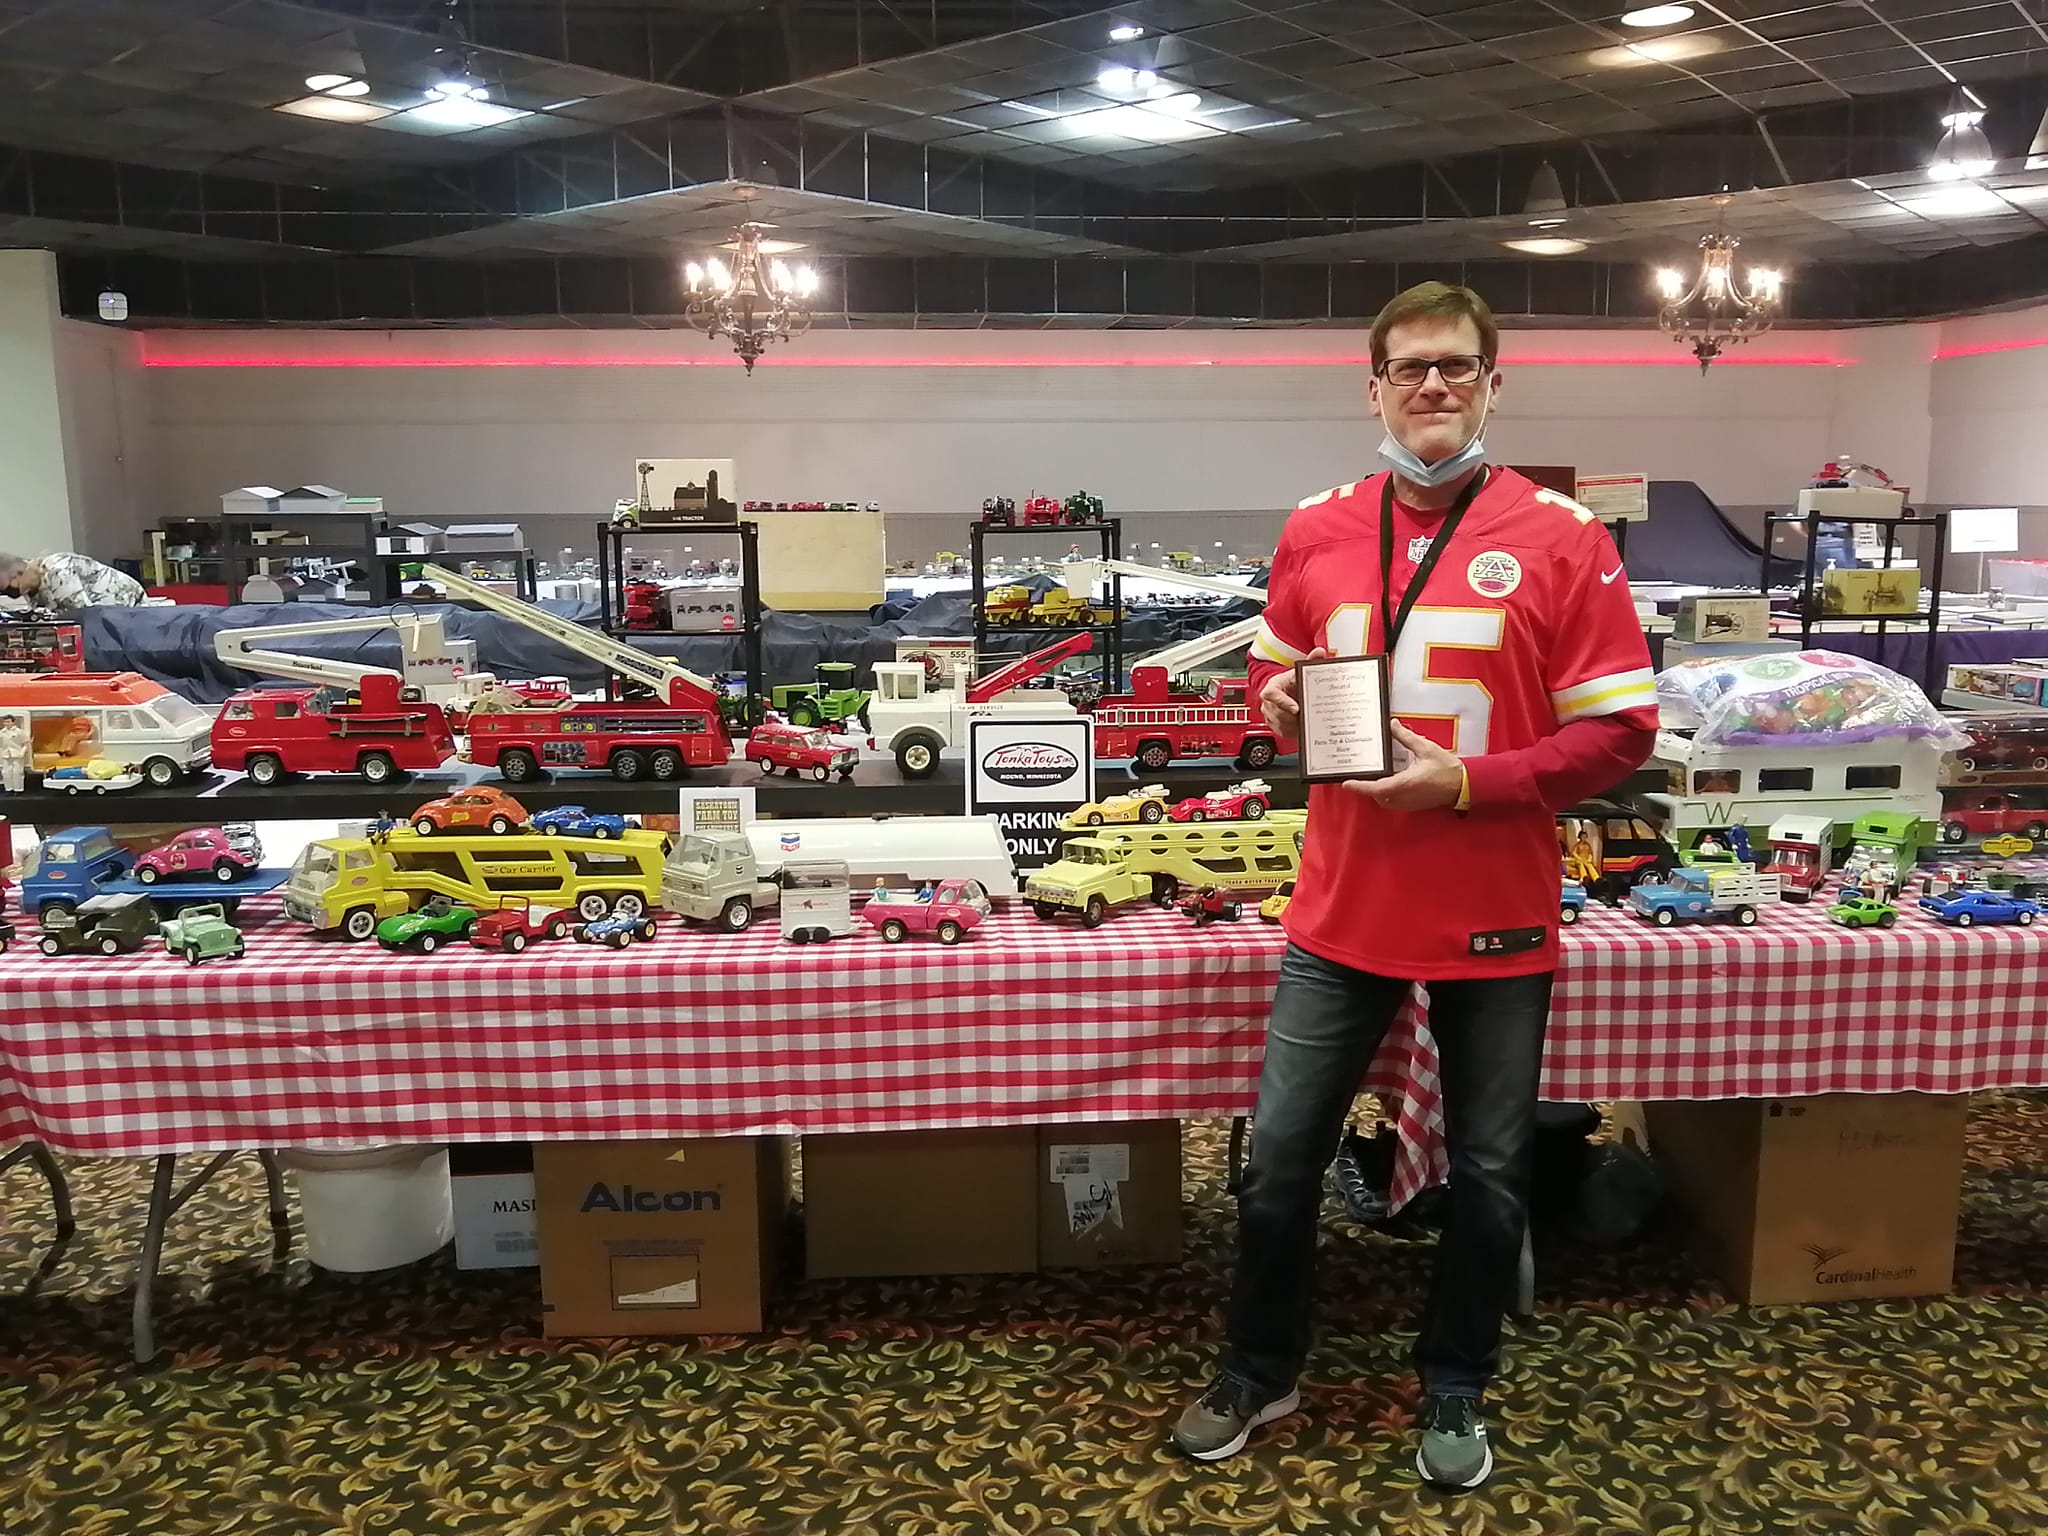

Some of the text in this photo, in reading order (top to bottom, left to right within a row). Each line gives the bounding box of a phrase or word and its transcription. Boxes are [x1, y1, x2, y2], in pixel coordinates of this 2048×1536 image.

[1782, 675, 1831, 698] TROPICAL
[995, 749, 1031, 766] Tonka
[1032, 748, 1063, 766] Toys
[696, 801, 738, 809] SASKATOON
[695, 810, 738, 820] FARM TOY
[987, 812, 1071, 830] ARKIN
[1005, 838, 1058, 855] ONLY
[499, 866, 517, 874] Car
[519, 865, 557, 873] Carrier
[580, 1182, 721, 1212] Alcon
